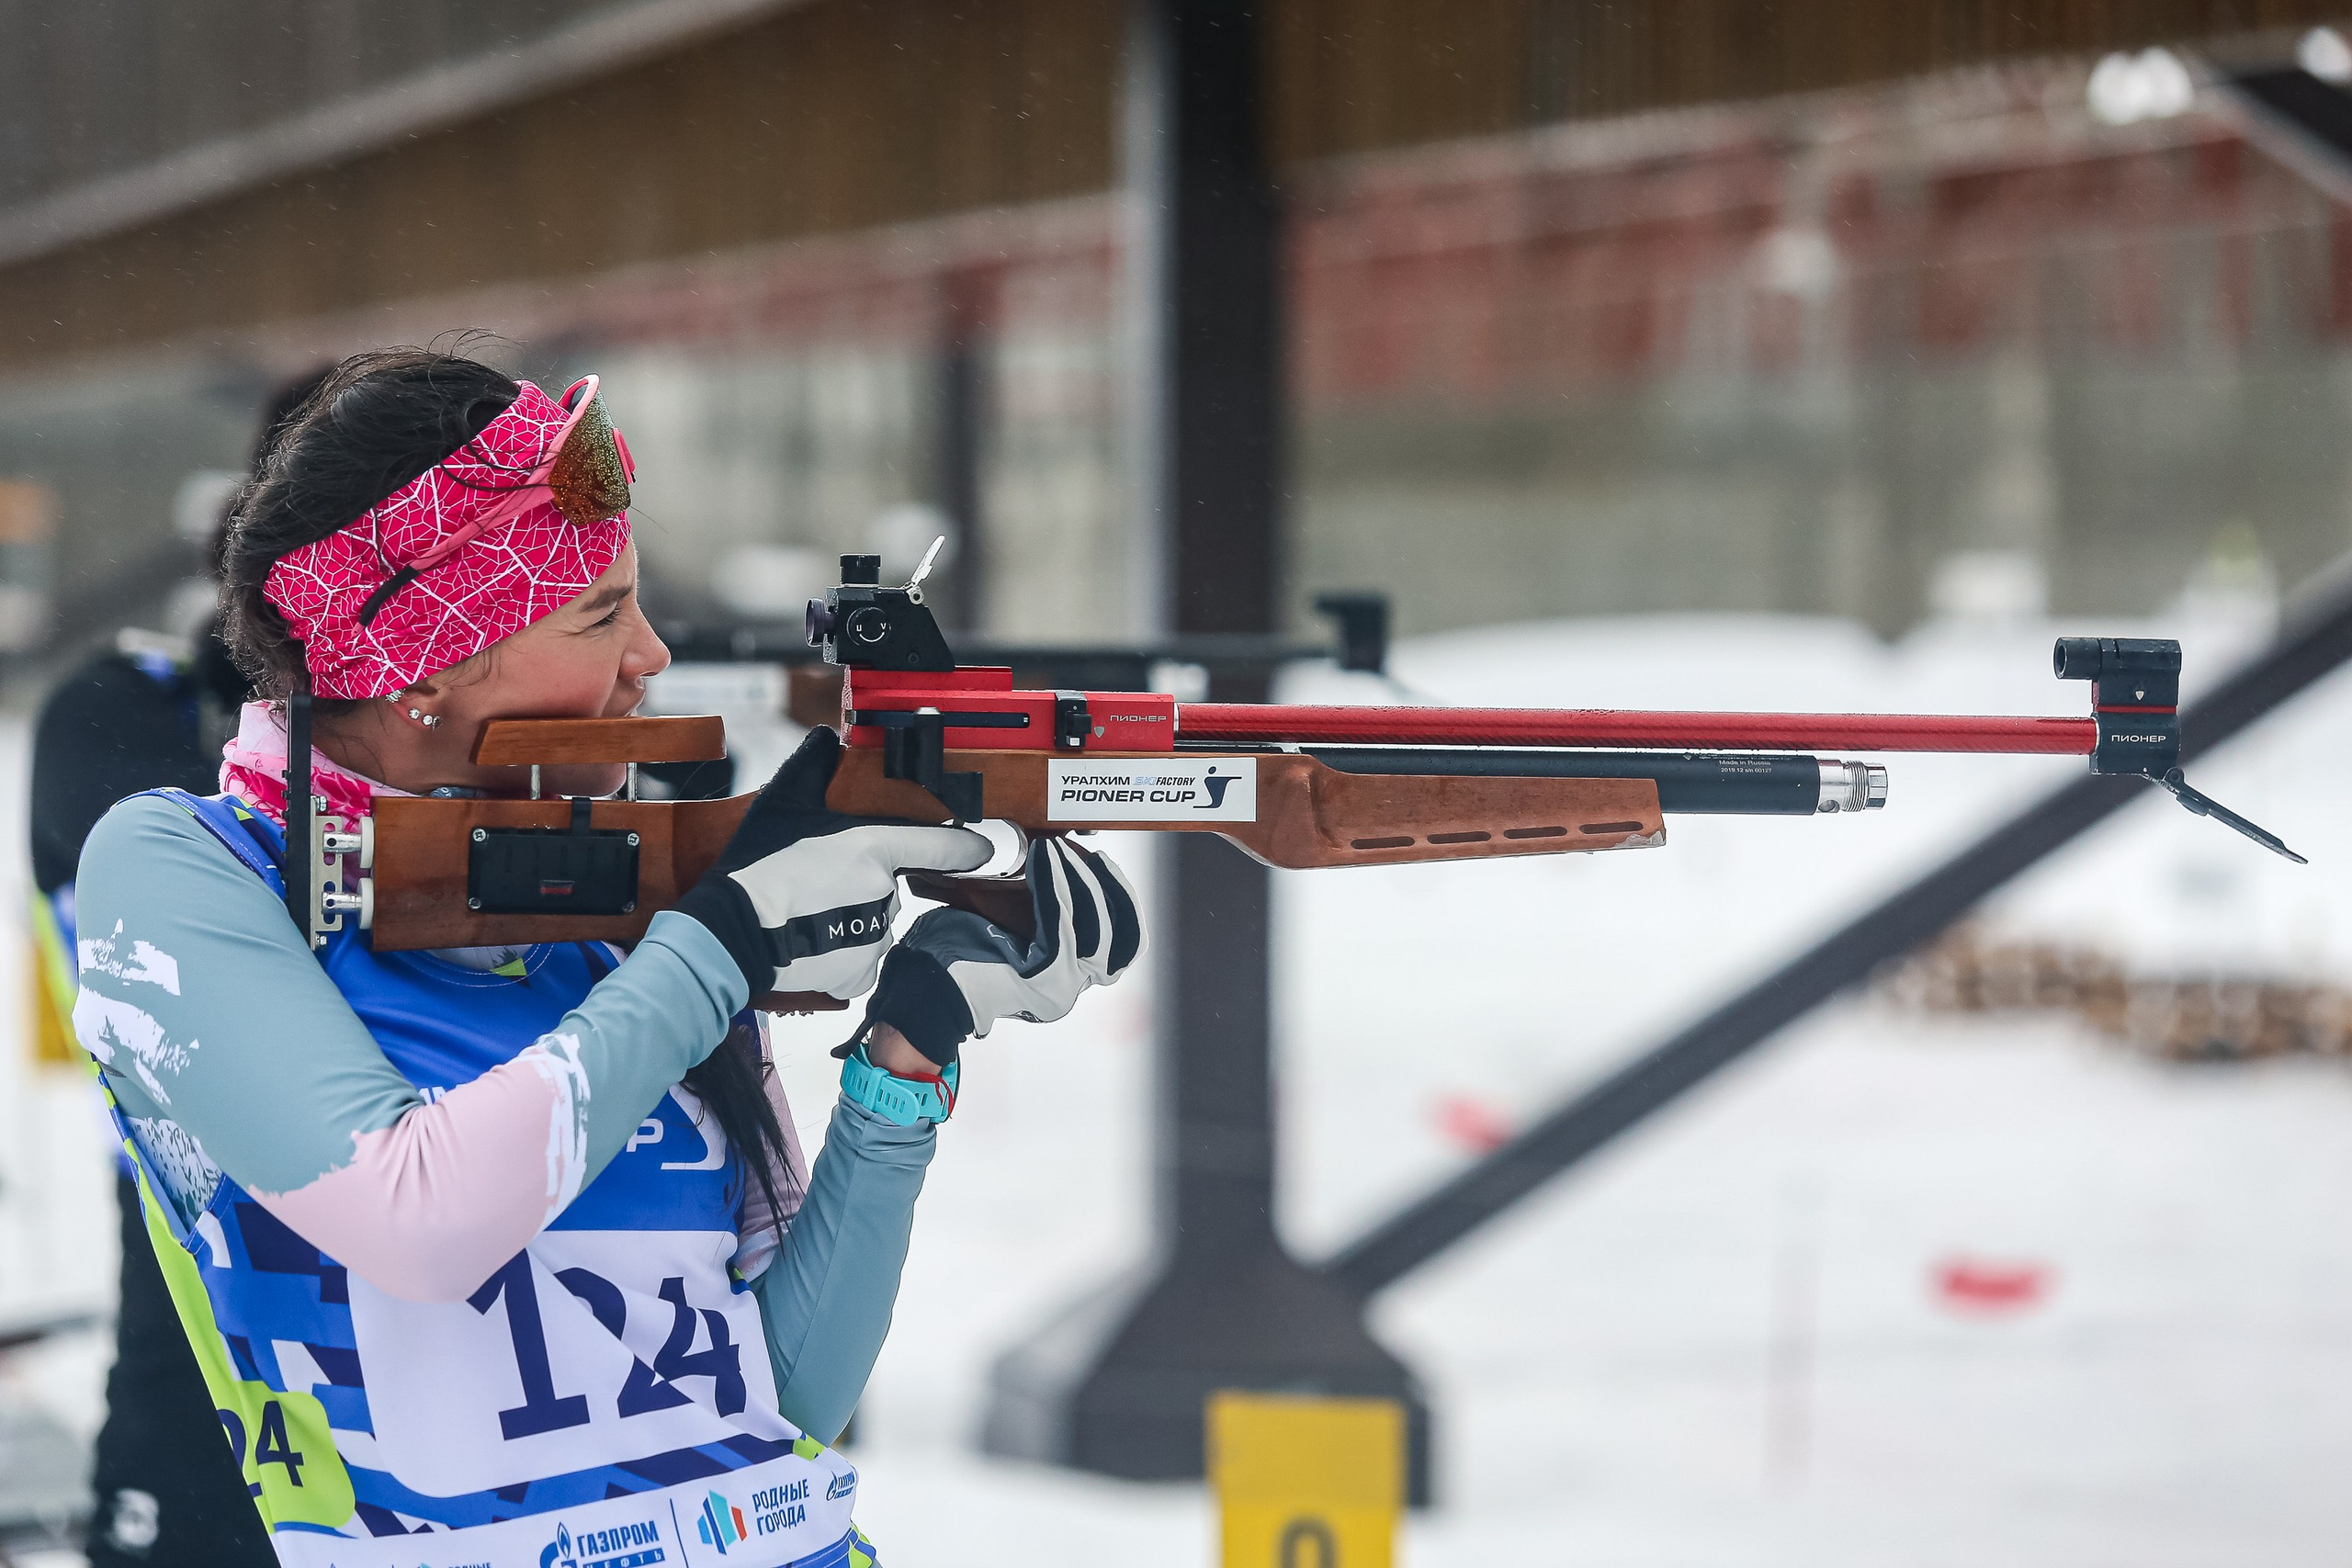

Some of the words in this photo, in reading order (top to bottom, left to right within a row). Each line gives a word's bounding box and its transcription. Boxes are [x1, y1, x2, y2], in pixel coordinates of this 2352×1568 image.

[2111, 735, 2166, 743] ПИОНЕР
[1061, 775, 1130, 785] УРАЛХИМ
[1060, 789, 1144, 803] PIONER
[1149, 789, 1196, 803] CUP
[828, 912, 888, 939] MOA
[465, 1247, 747, 1441] 124
[752, 1478, 811, 1513] РОДНЫЕ
[756, 1504, 808, 1536] ГОРОДА
[576, 1520, 660, 1557] ГАЗПРОМ
